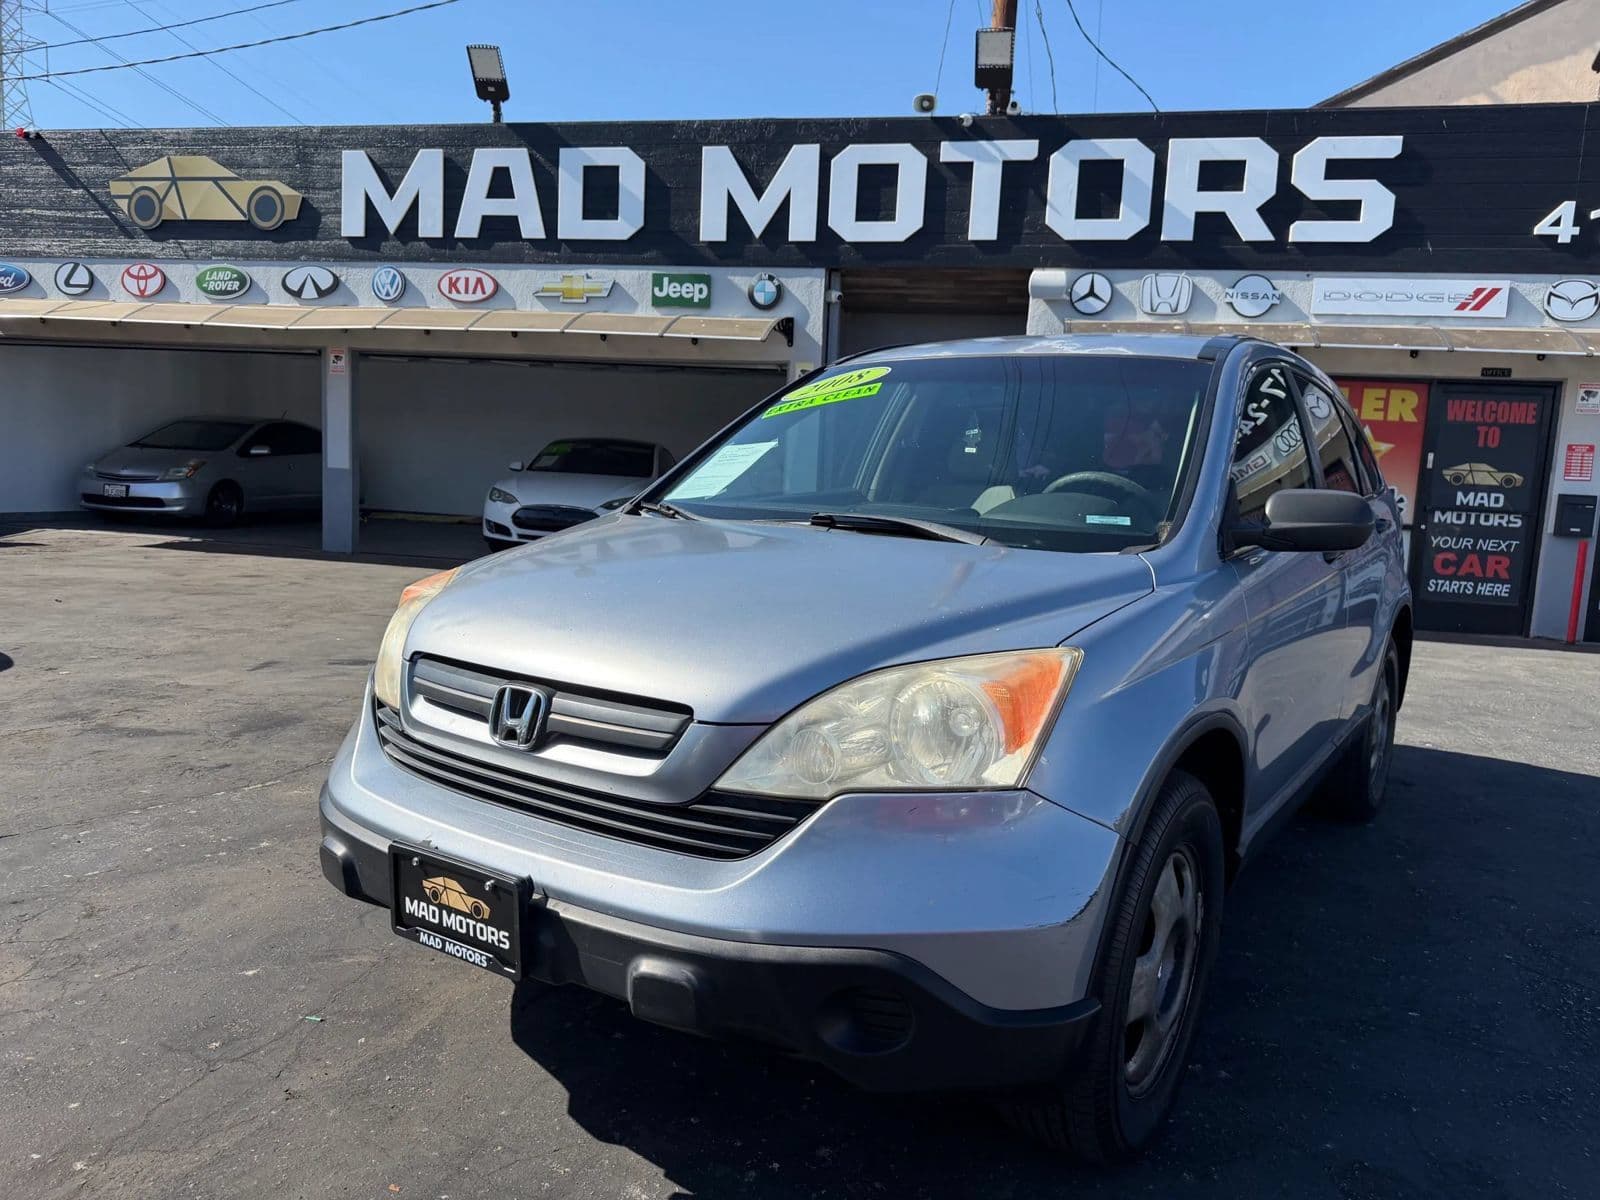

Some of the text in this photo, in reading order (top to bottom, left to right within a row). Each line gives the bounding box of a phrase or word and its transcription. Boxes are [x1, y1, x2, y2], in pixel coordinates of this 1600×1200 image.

[340, 135, 1404, 243] MAD MOTORS
[205, 270, 232, 281] LAND
[207, 281, 240, 291] ROVER
[448, 276, 486, 295] KIA
[653, 277, 708, 303] Jeep
[1224, 291, 1281, 301] NISSAN
[822, 384, 879, 402] CLEAN
[1447, 399, 1537, 424] WELCOME
[1476, 426, 1501, 448] TO
[1456, 491, 1505, 508] MAD
[1433, 510, 1523, 528] MOTORS
[1430, 535, 1520, 553] YOUR NEXT
[1432, 551, 1511, 580] CAR
[1427, 579, 1511, 597] STARTS HERE
[404, 896, 510, 950] MAD MOTORS
[419, 932, 487, 967] MAD MOTORS
